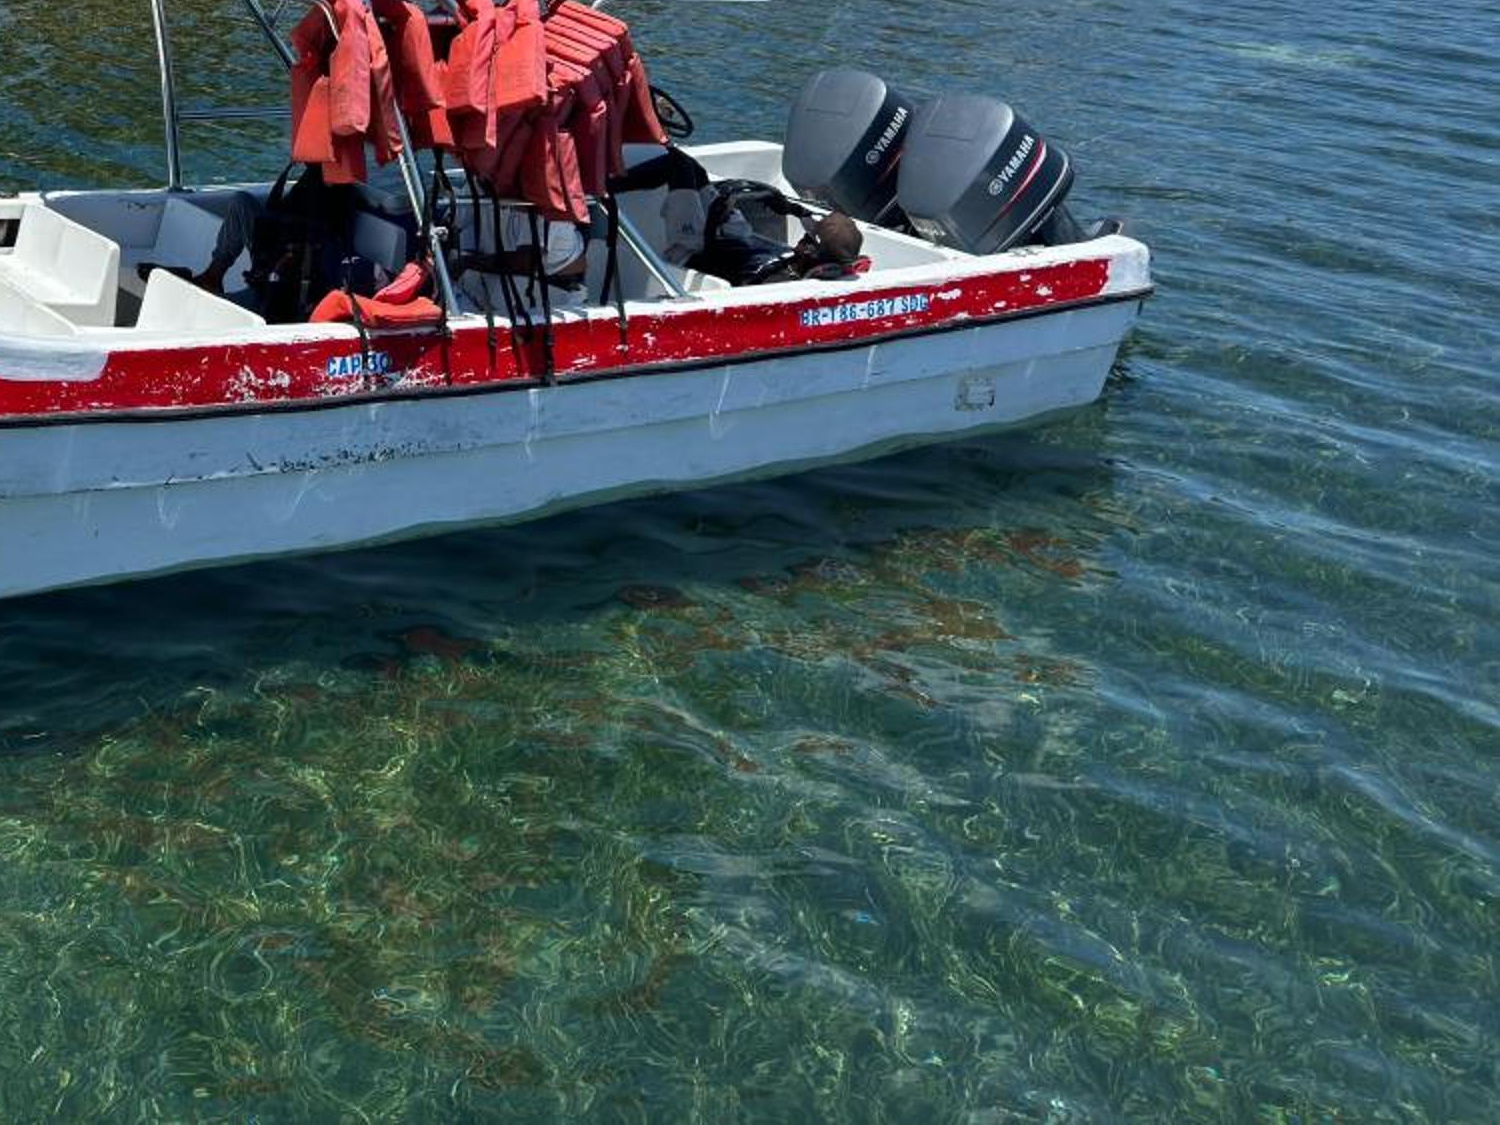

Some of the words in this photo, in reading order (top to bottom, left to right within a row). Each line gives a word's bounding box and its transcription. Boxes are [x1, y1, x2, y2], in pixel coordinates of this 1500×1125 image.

[874, 106, 909, 153] YAMAHA
[998, 134, 1035, 183] YAMAHA
[327, 353, 361, 377] CAP
